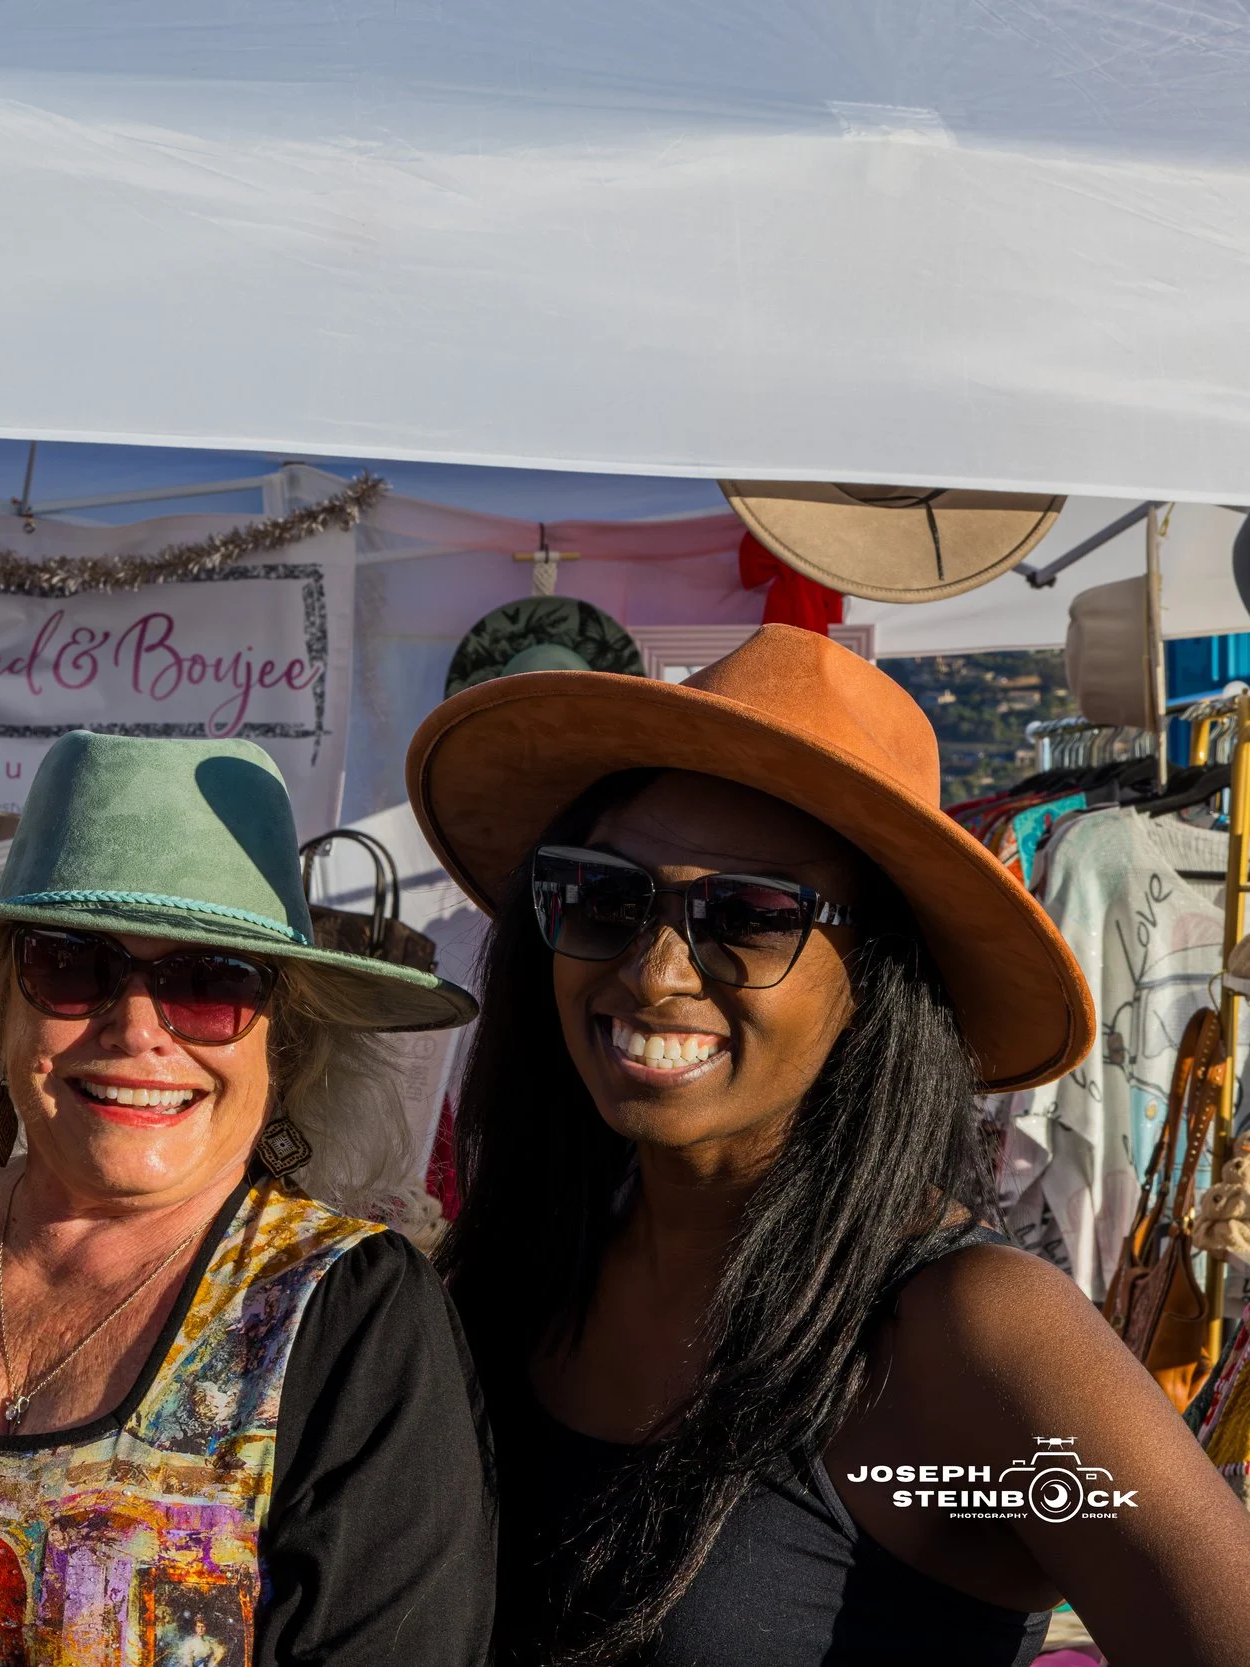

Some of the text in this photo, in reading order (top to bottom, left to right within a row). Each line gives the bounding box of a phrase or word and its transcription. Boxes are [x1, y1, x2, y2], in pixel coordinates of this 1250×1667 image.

[53, 626, 111, 692] &
[114, 611, 322, 739] Boujee
[1115, 872, 1173, 987] Love
